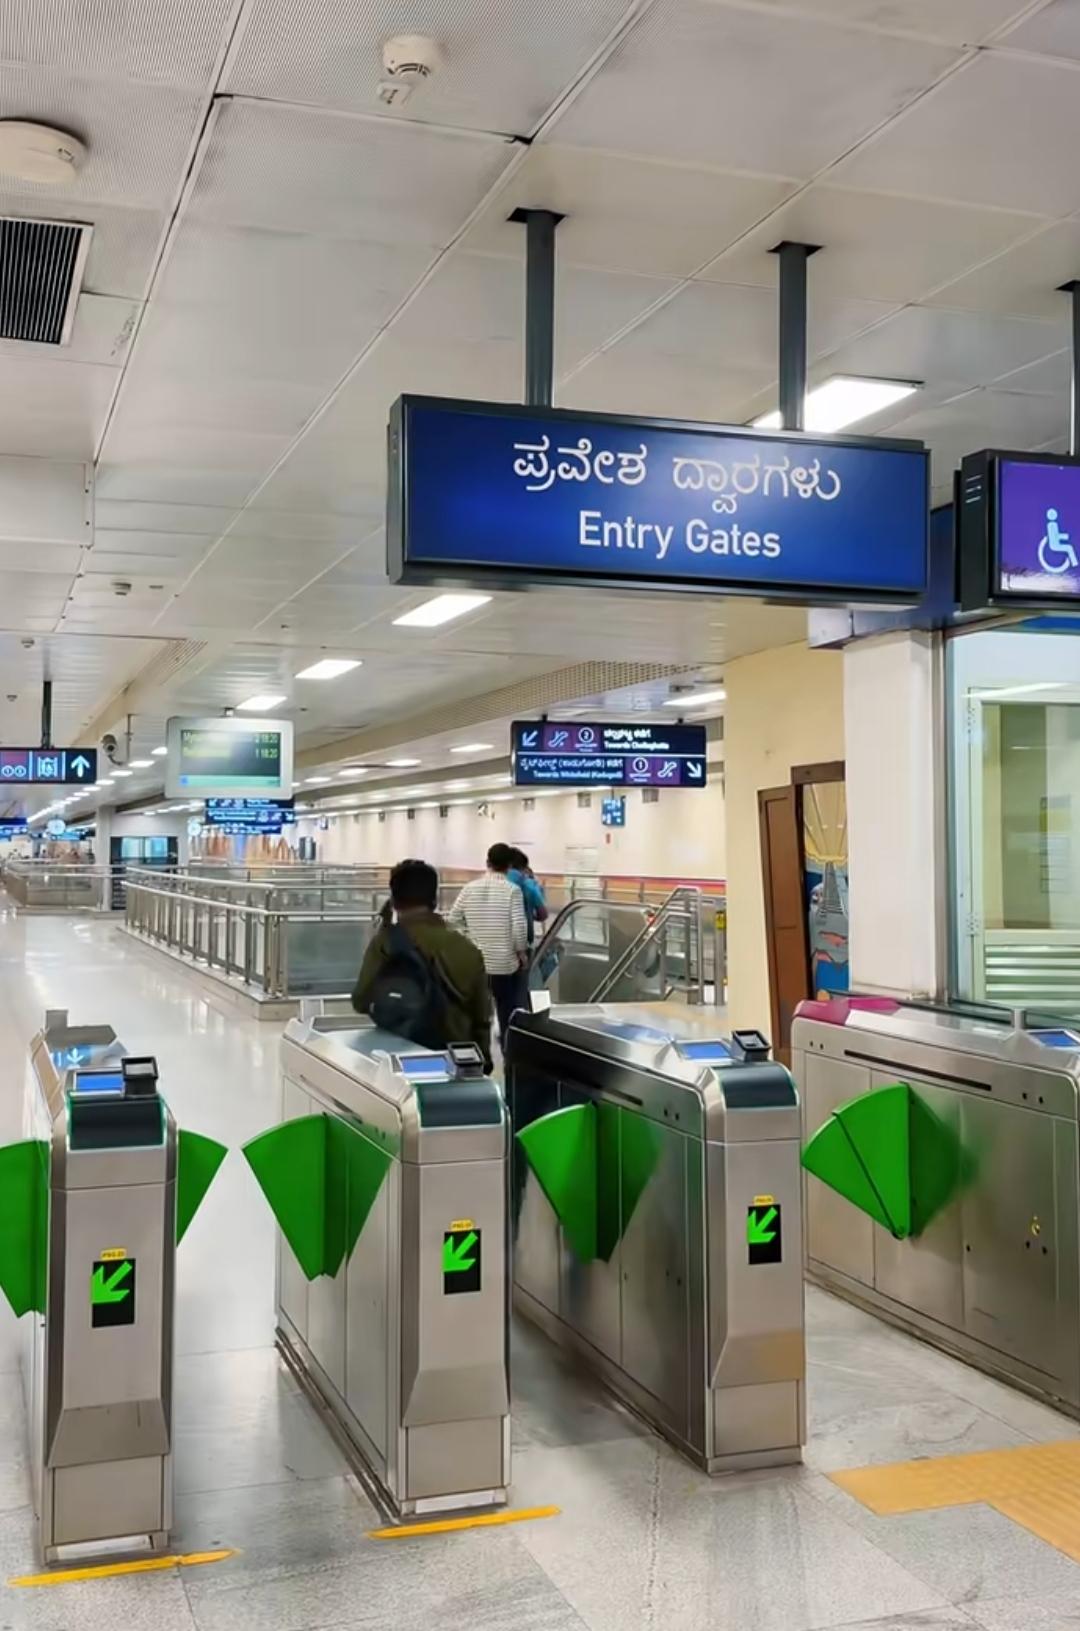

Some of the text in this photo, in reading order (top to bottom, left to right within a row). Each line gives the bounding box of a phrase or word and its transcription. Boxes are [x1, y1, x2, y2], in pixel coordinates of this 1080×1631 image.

[513, 435, 841, 514] ಪ್ರವೇಶ ದ್ವಾರಗಳು
[578, 509, 781, 560] Entry Gates
